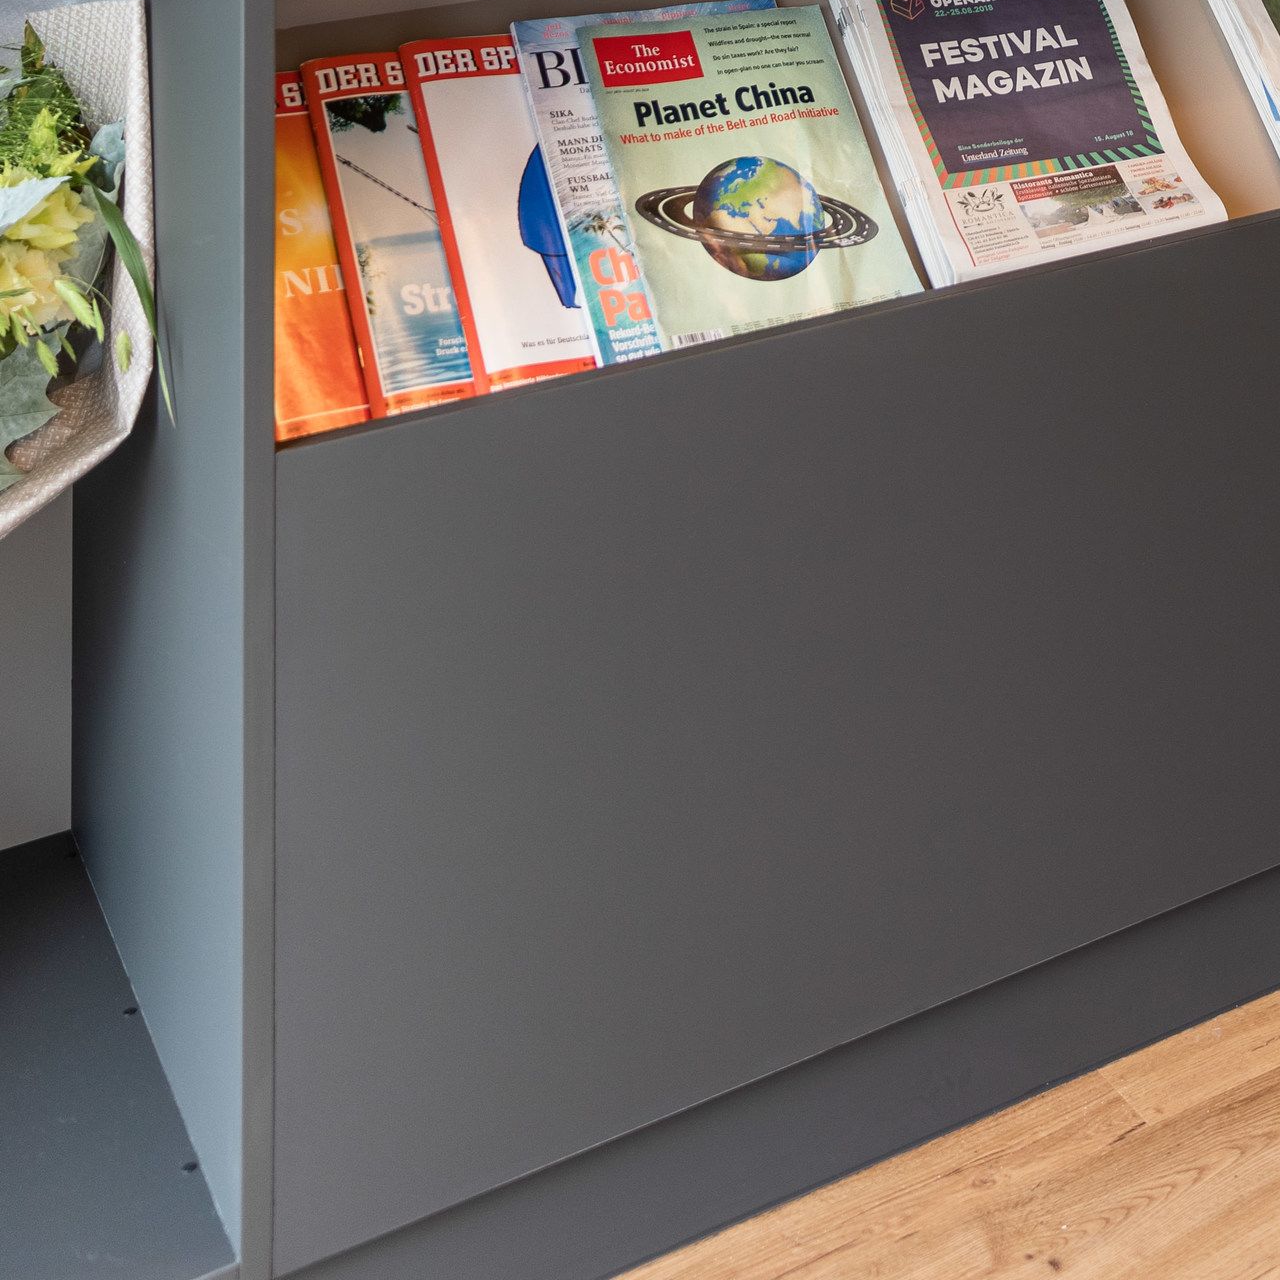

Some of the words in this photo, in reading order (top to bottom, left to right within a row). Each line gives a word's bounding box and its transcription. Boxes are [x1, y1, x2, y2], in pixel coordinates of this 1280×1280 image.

[935, 4, 993, 17] 22.-25.08.2018
[761, 20, 779, 28] special
[631, 44, 660, 57] The
[920, 24, 1078, 68] FESTIVAL
[414, 48, 477, 78] DER
[604, 54, 695, 75] Economist
[316, 65, 381, 94] DER
[932, 56, 1093, 103] MAGAZIN
[550, 110, 574, 118] SIKA
[634, 93, 731, 127] Planet
[735, 82, 815, 111] China
[620, 134, 648, 145] What
[650, 133, 662, 142] to
[664, 129, 692, 140] make
[695, 125, 704, 135] of
[707, 123, 724, 134] the
[726, 118, 747, 130] Belt
[750, 117, 768, 126] and
[771, 111, 796, 122] Road
[798, 107, 839, 118] Initiative
[962, 151, 998, 163] Unterland
[999, 147, 1028, 159] Zeitung
[569, 185, 589, 193] WM
